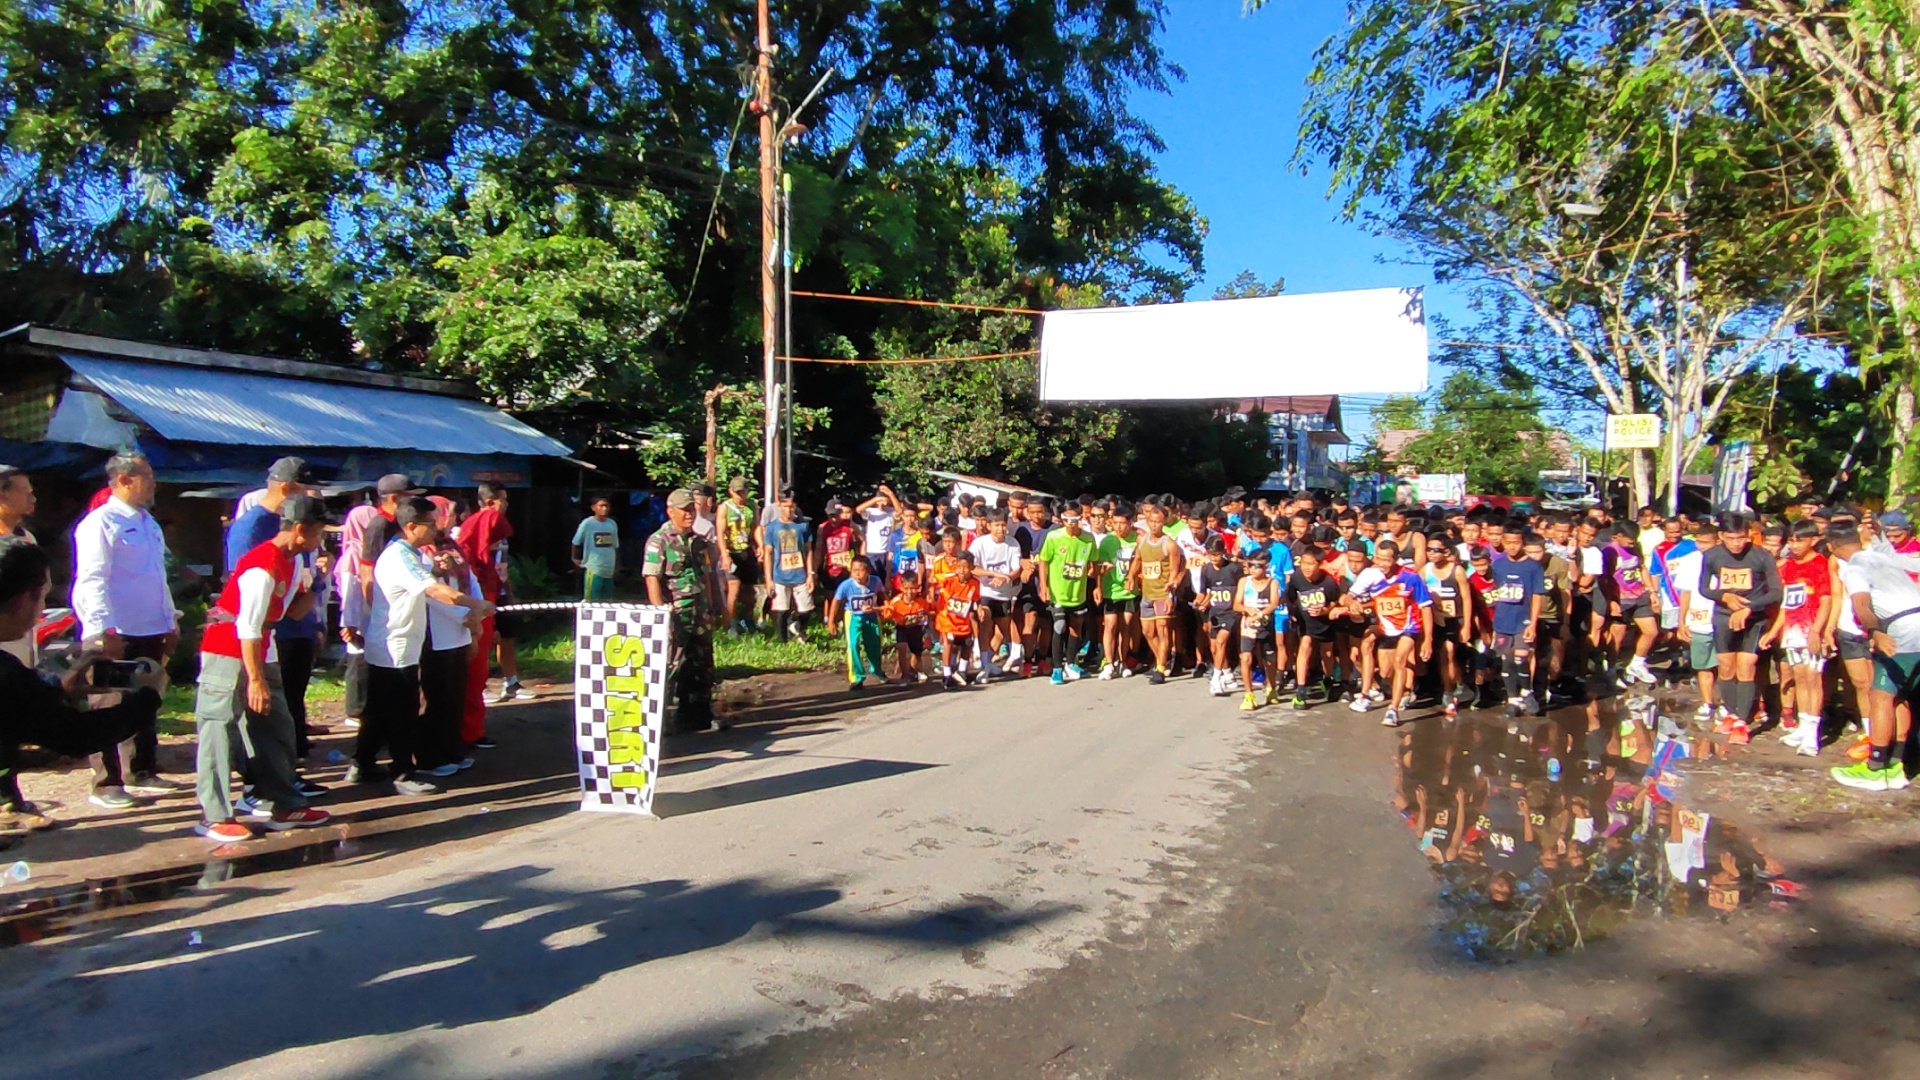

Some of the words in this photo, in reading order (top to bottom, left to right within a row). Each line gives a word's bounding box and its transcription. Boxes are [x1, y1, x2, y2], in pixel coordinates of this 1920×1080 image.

[1613, 417, 1652, 427] POLISI
[1613, 427, 1652, 436] POLICE
[783, 556, 801, 567] 112
[833, 554, 850, 565] 216
[1189, 557, 1205, 568] 16
[1062, 564, 1083, 578] 299
[1722, 573, 1748, 585] 217
[1210, 589, 1231, 603] 210
[1500, 586, 1524, 599] 218
[1300, 590, 1325, 608] 340
[947, 598, 969, 616] 337
[1379, 600, 1402, 612] 134
[604, 634, 646, 793] START
